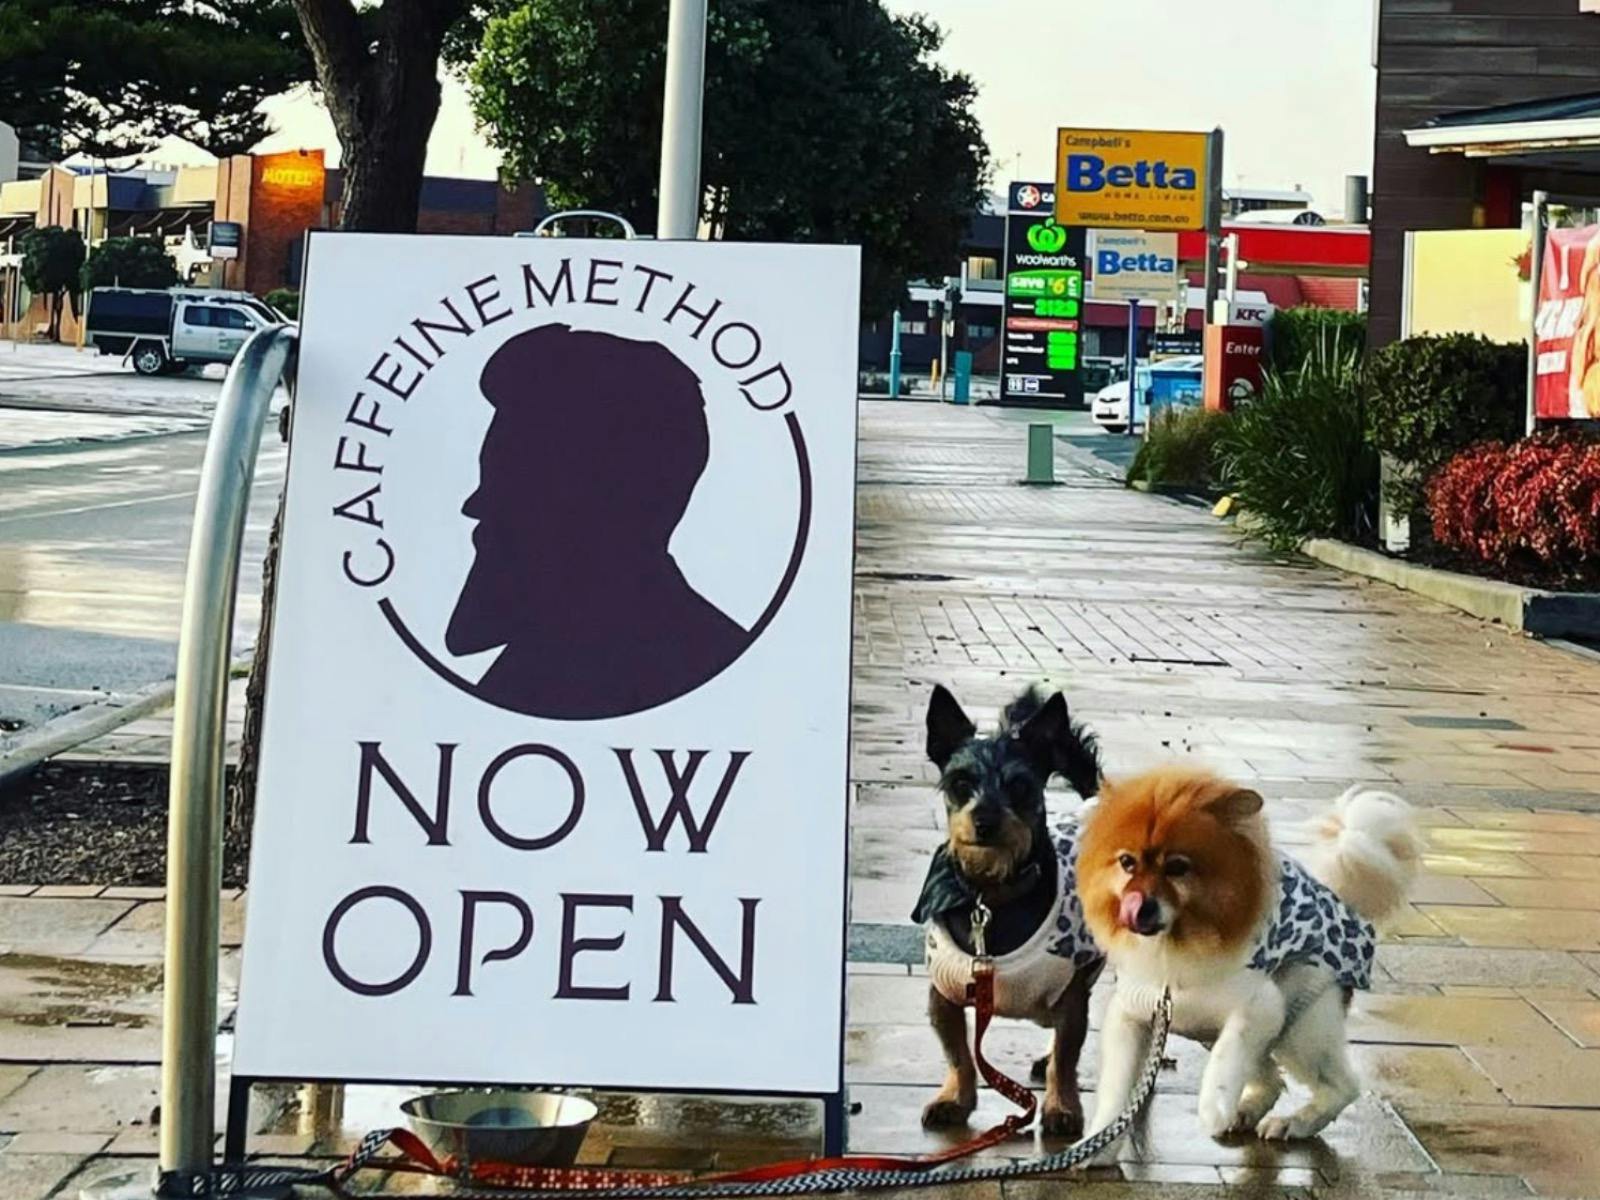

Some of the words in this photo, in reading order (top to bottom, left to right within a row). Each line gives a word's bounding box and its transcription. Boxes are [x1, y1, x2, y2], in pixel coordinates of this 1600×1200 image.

[1066, 135, 1130, 149] Campbell's
[261, 167, 313, 186] MOTEL
[1067, 154, 1197, 192] Betta
[1097, 249, 1174, 275] Betta
[1236, 307, 1267, 321] KFC
[1225, 341, 1262, 355] Enter
[332, 274, 513, 587] CAFFEINE
[520, 258, 793, 411] METHOD
[347, 740, 754, 853] NOW
[321, 885, 763, 1005] OPEN
